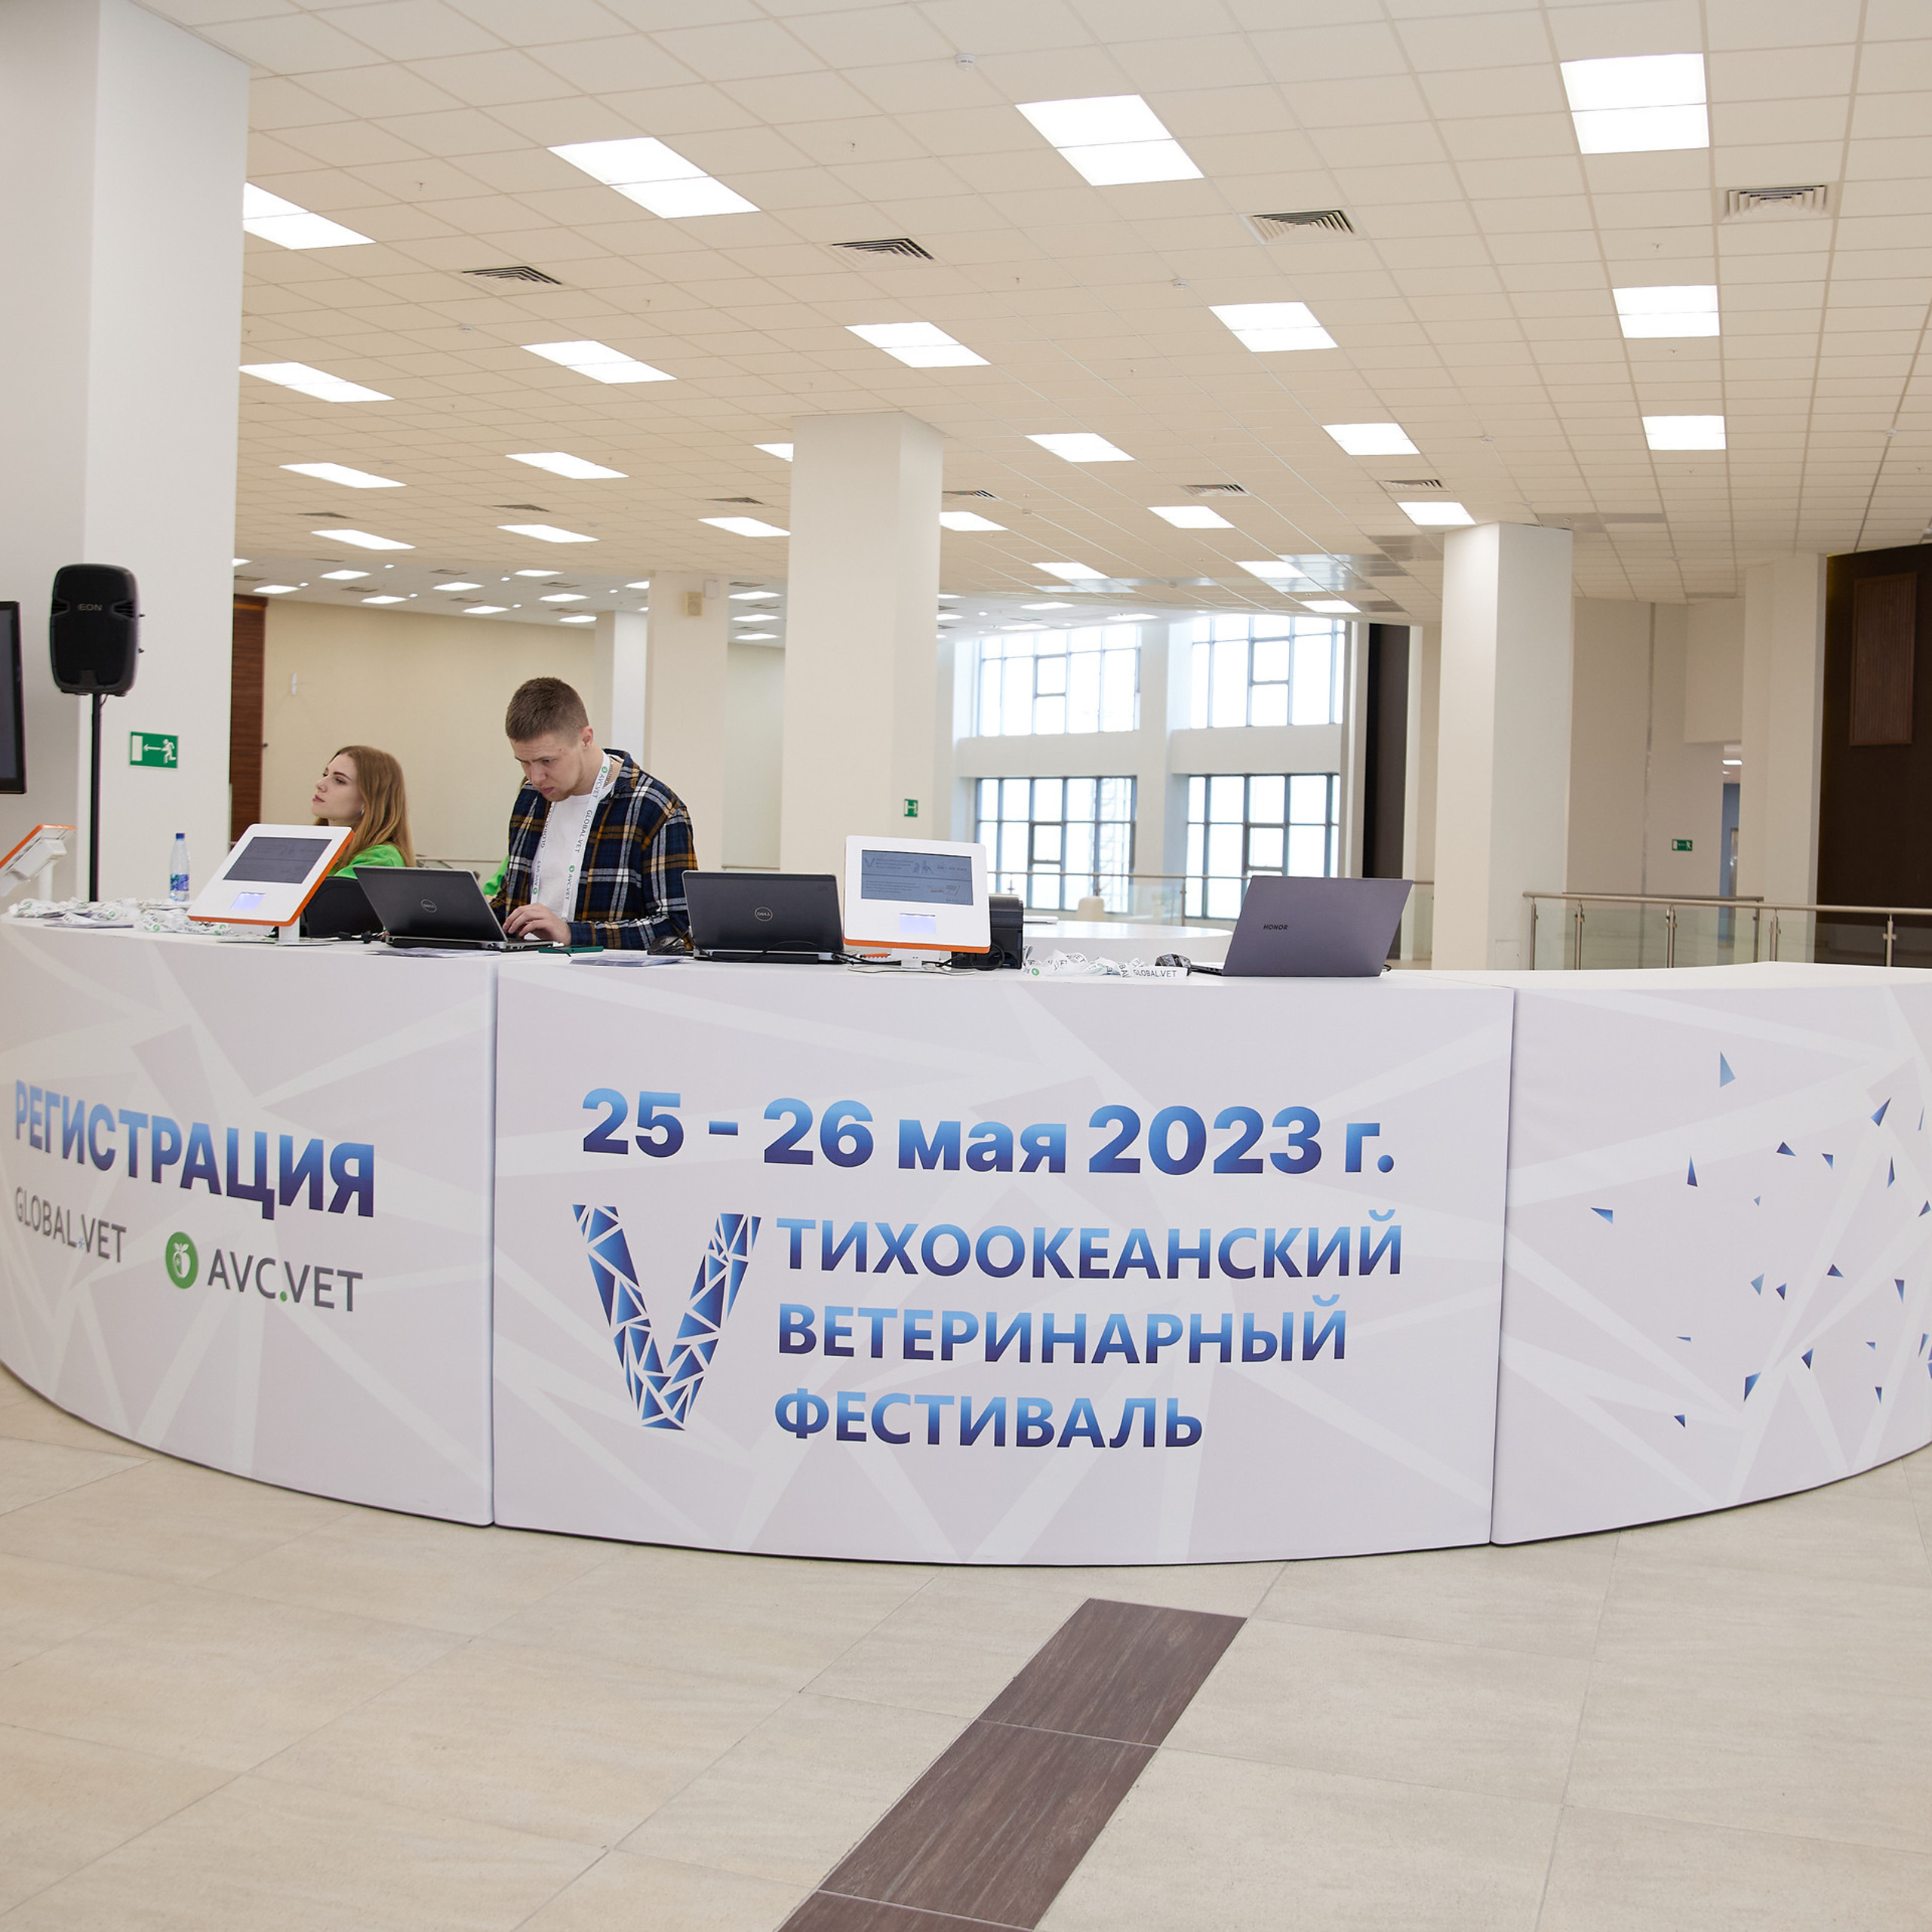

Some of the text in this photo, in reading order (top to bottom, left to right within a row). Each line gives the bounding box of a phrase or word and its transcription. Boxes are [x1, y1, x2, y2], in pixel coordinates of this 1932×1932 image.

[79, 603, 103, 611] EON
[15, 1080, 375, 1220] РЕГИСТРАЦИЯ
[582, 1088, 685, 1158] 25
[764, 1097, 874, 1168] 26
[898, 1118, 1067, 1173] мая
[1088, 1105, 1322, 1176] 2023
[1346, 1121, 1395, 1174] г.
[777, 1209, 1402, 1280] ТИХООКЕАНСКИЙ
[207, 1248, 364, 1312] AVC.VET
[779, 1294, 1346, 1364] ВЕТЕРИНАРНЫЙ
[775, 1388, 1202, 1449] ФЕСТИВАЛЬ
